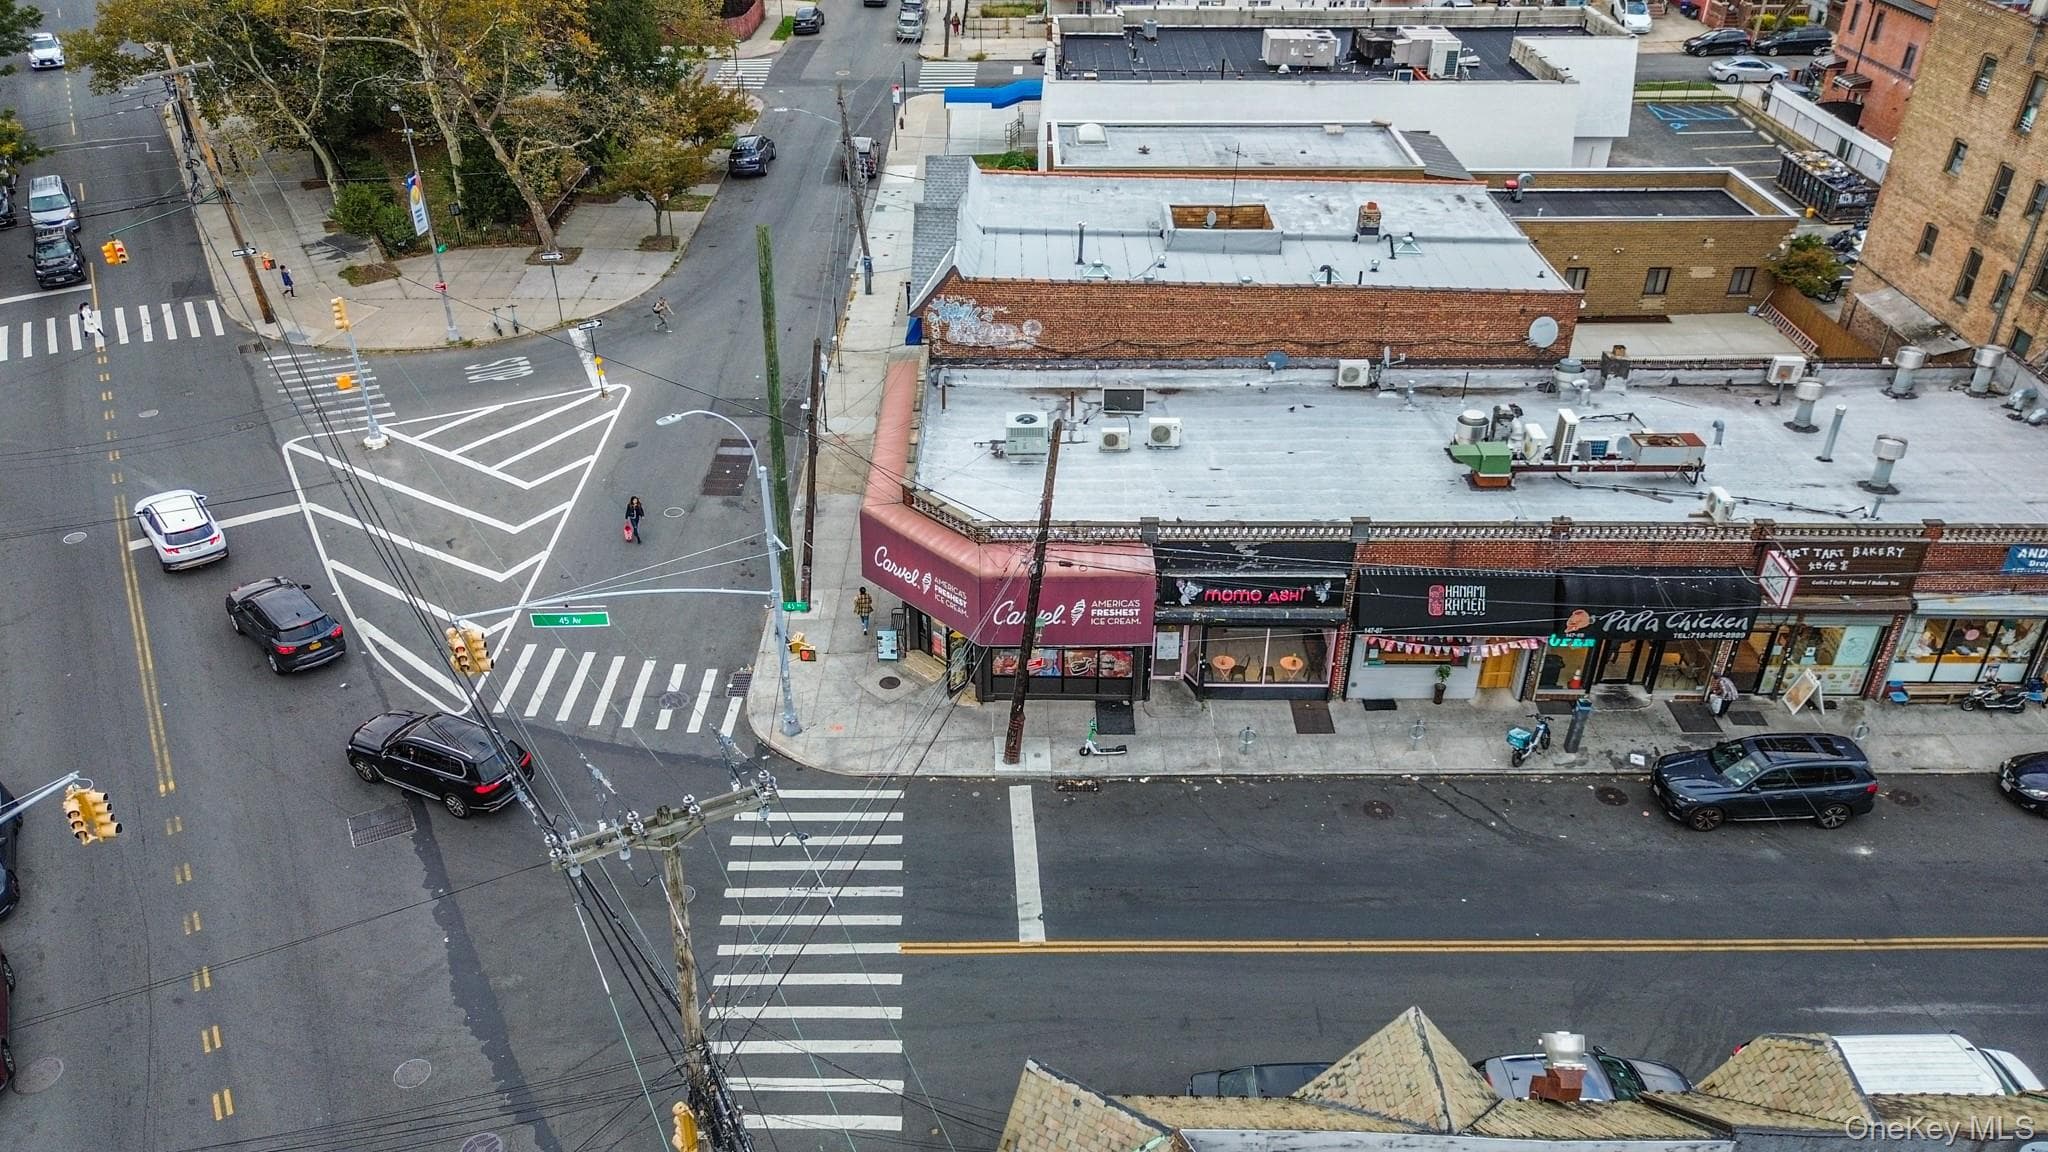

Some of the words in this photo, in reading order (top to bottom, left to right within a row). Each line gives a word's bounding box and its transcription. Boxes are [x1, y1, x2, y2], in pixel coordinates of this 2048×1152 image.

[1777, 548, 1810, 559] ART
[1812, 548, 1845, 559] TART
[1852, 546, 1905, 558] BAKERY
[874, 546, 919, 587] Carvel
[934, 584, 968, 608] FRESHEST
[1445, 585, 1486, 598] HANAMI
[1091, 599, 1141, 608] AMERICA'S
[1445, 598, 1486, 612] RAMEN
[1091, 608, 1141, 617] FRESHEST
[558, 616, 570, 625] 45
[1091, 617, 1105, 626] ICE
[1665, 611, 1749, 633] Chicken
